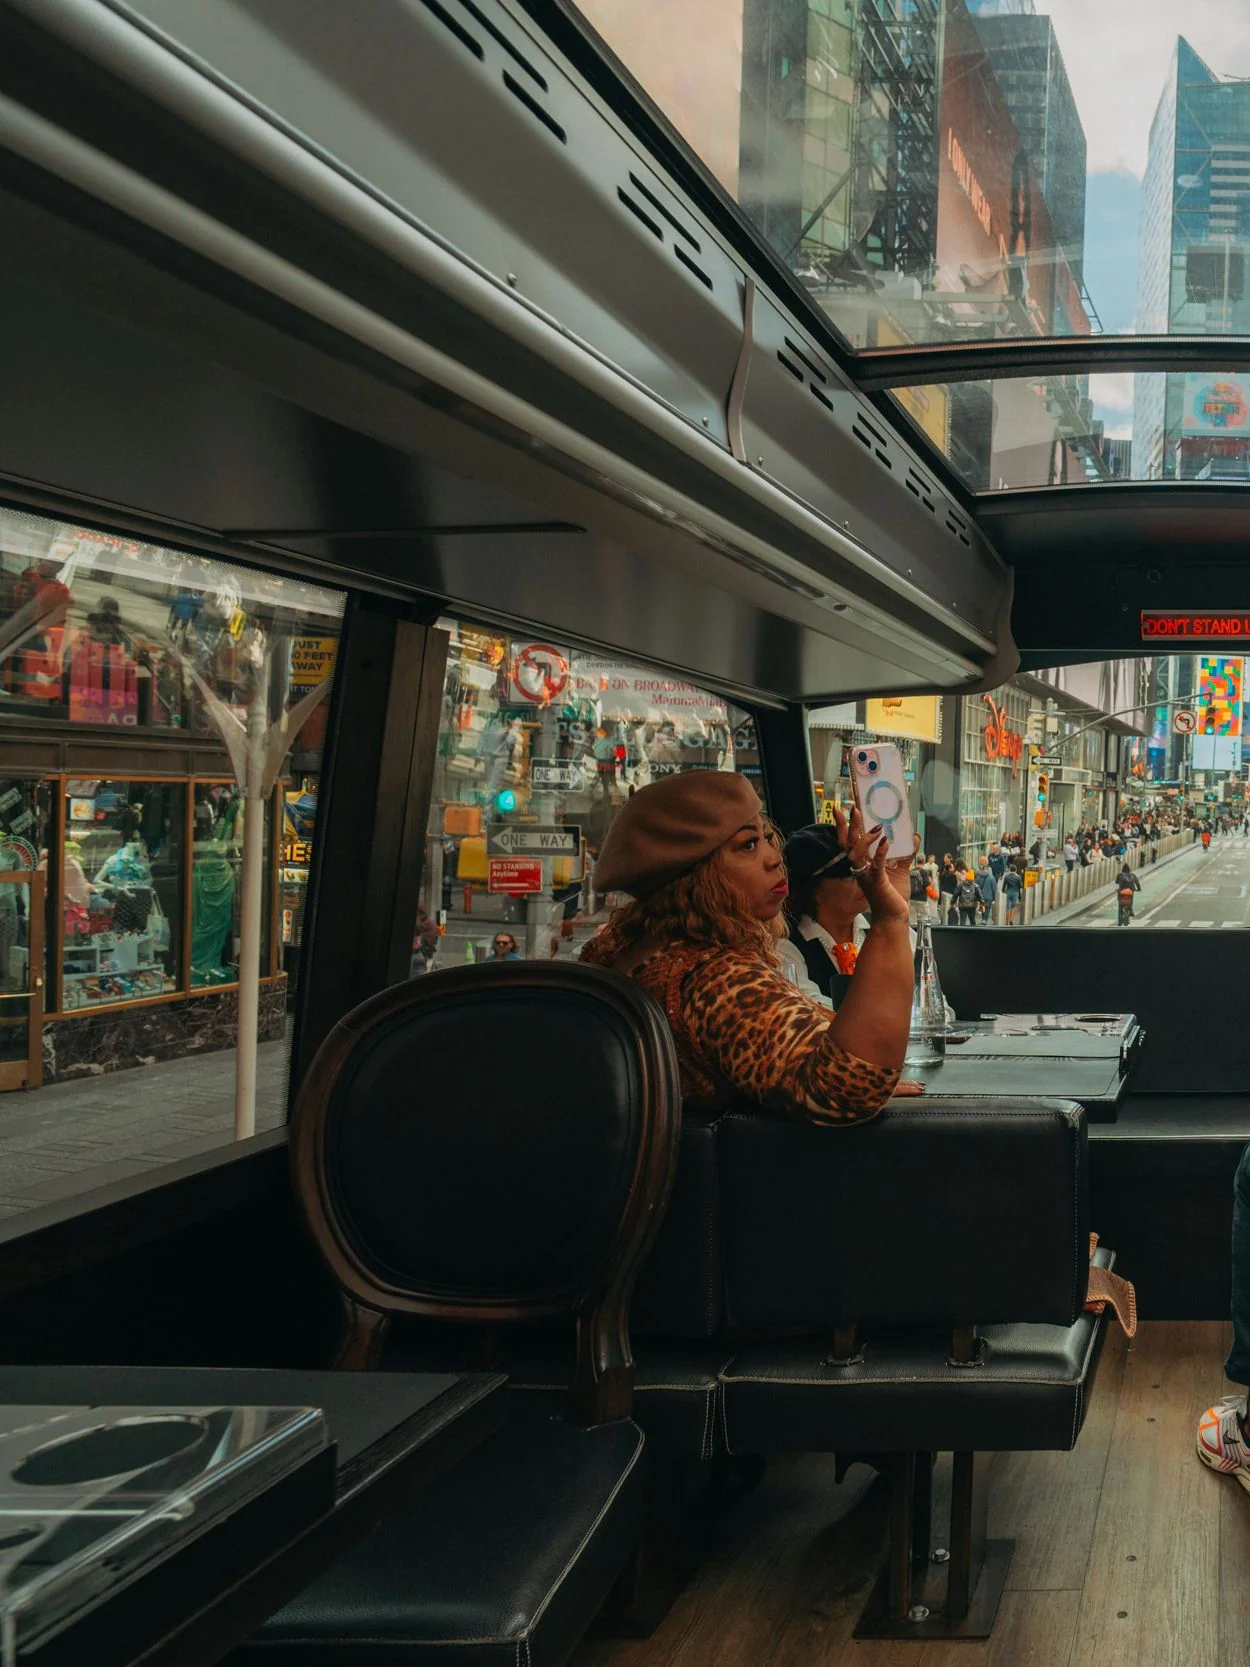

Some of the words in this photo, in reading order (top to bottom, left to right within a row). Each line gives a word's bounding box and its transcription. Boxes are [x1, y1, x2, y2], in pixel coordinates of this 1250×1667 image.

[1147, 618, 1190, 634] DON'T
[1192, 618, 1241, 634] STAND
[535, 768, 551, 781] ONE
[501, 833, 528, 847] ONE
[539, 833, 568, 847] WAY
